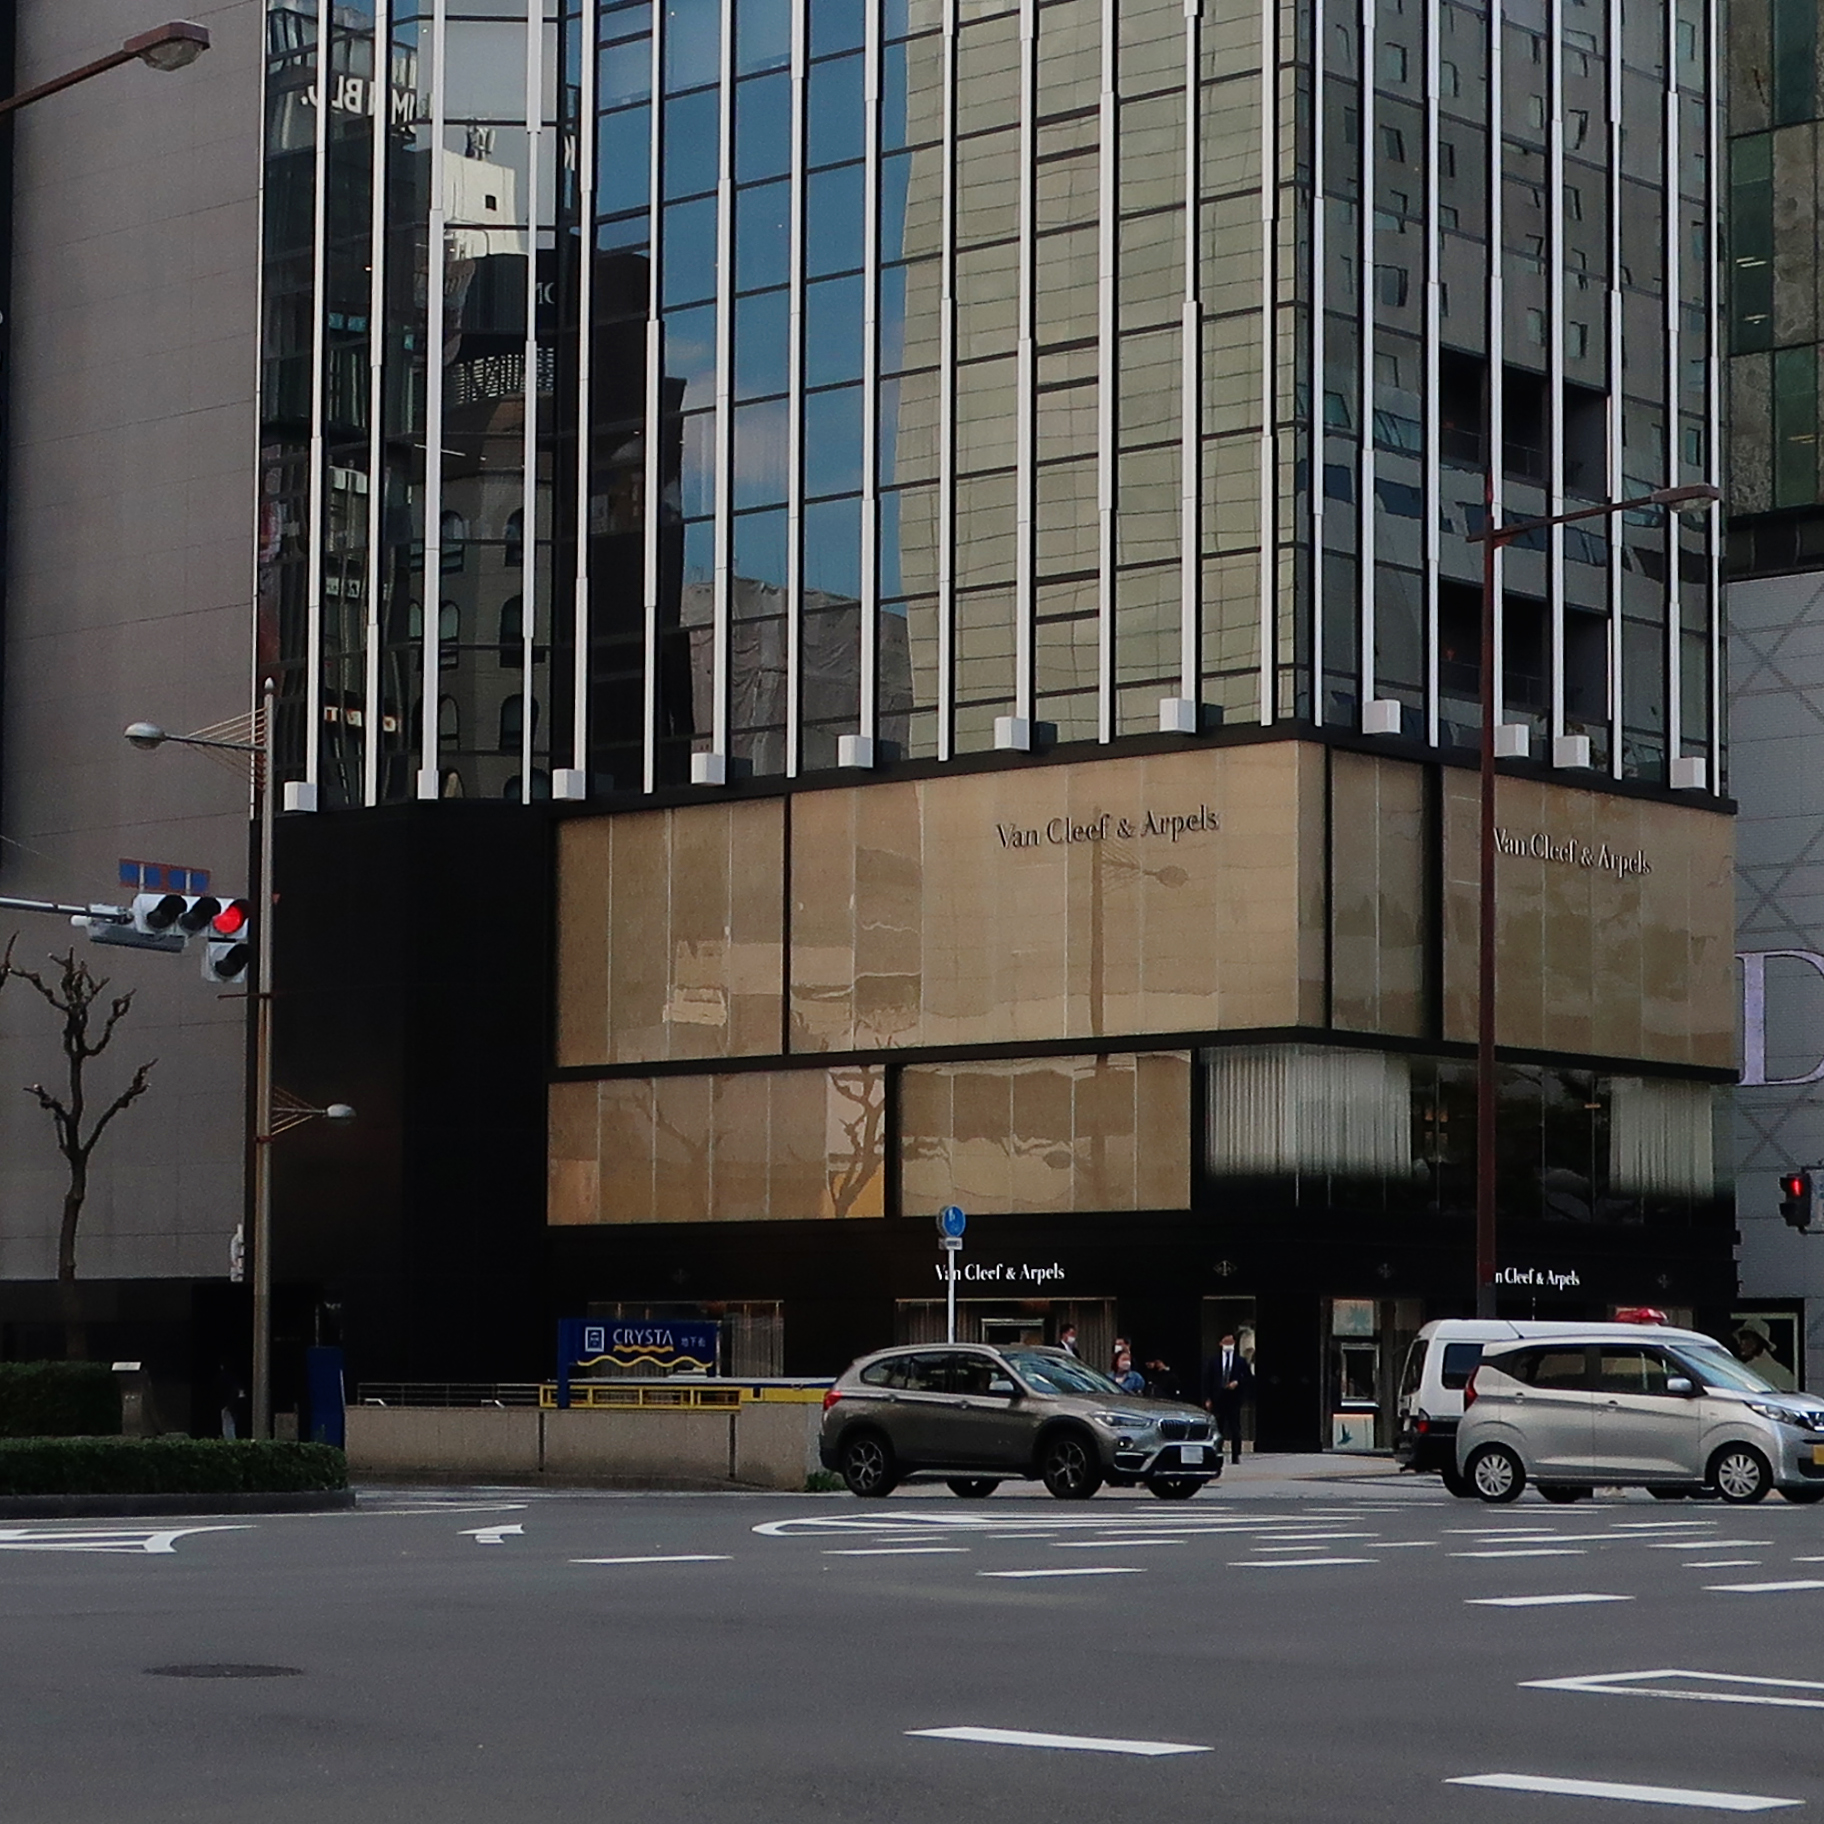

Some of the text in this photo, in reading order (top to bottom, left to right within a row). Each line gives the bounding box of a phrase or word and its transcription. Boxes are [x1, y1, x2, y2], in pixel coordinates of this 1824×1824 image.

[996, 803, 1220, 849] Van Cleef & Arpels
[1493, 827, 1652, 878] Van Cleef & Arpels
[964, 1263, 1004, 1281] Cleef
[1005, 1267, 1016, 1281] &
[1019, 1262, 1065, 1286] Arpels
[1504, 1266, 1535, 1285] Cleef
[1536, 1271, 1545, 1285] &
[1546, 1269, 1581, 1291] Arpels
[612, 1328, 674, 1345] CRYSTA
